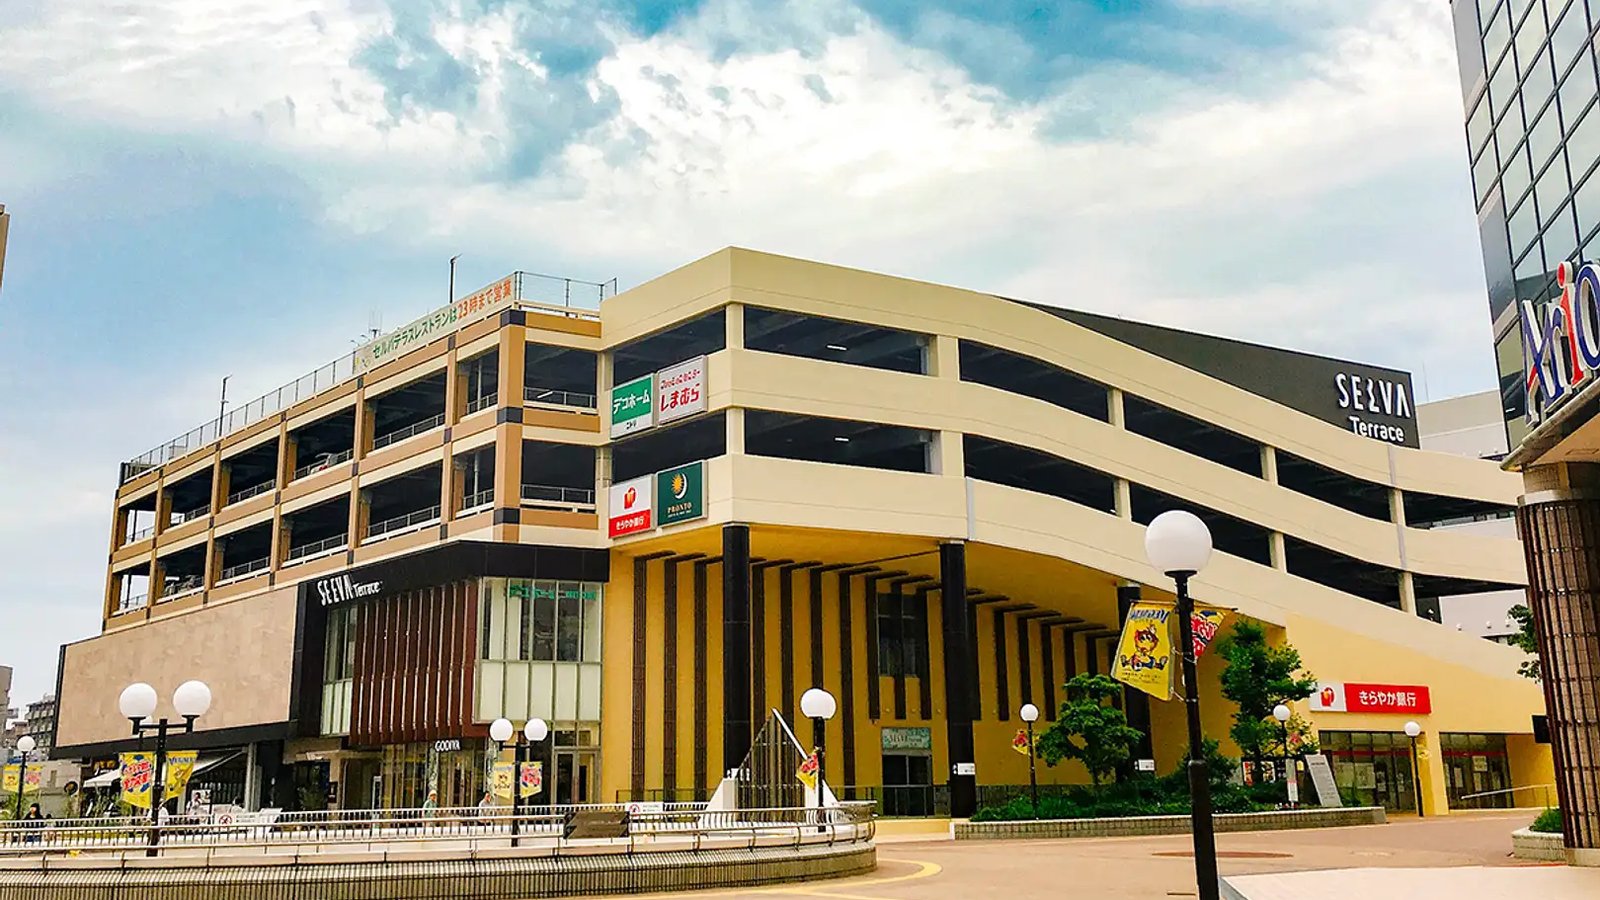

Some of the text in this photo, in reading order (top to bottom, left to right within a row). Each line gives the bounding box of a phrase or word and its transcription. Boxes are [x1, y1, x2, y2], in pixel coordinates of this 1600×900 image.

[613, 389, 650, 414] デコホーム
[660, 383, 700, 412] しまむら
[1348, 415, 1404, 442] Terrace
[667, 502, 692, 513] PRONTO
[616, 515, 645, 531] きらやか銀行
[352, 581, 381, 598] Terrace
[1358, 690, 1417, 707] きらやか銀行
